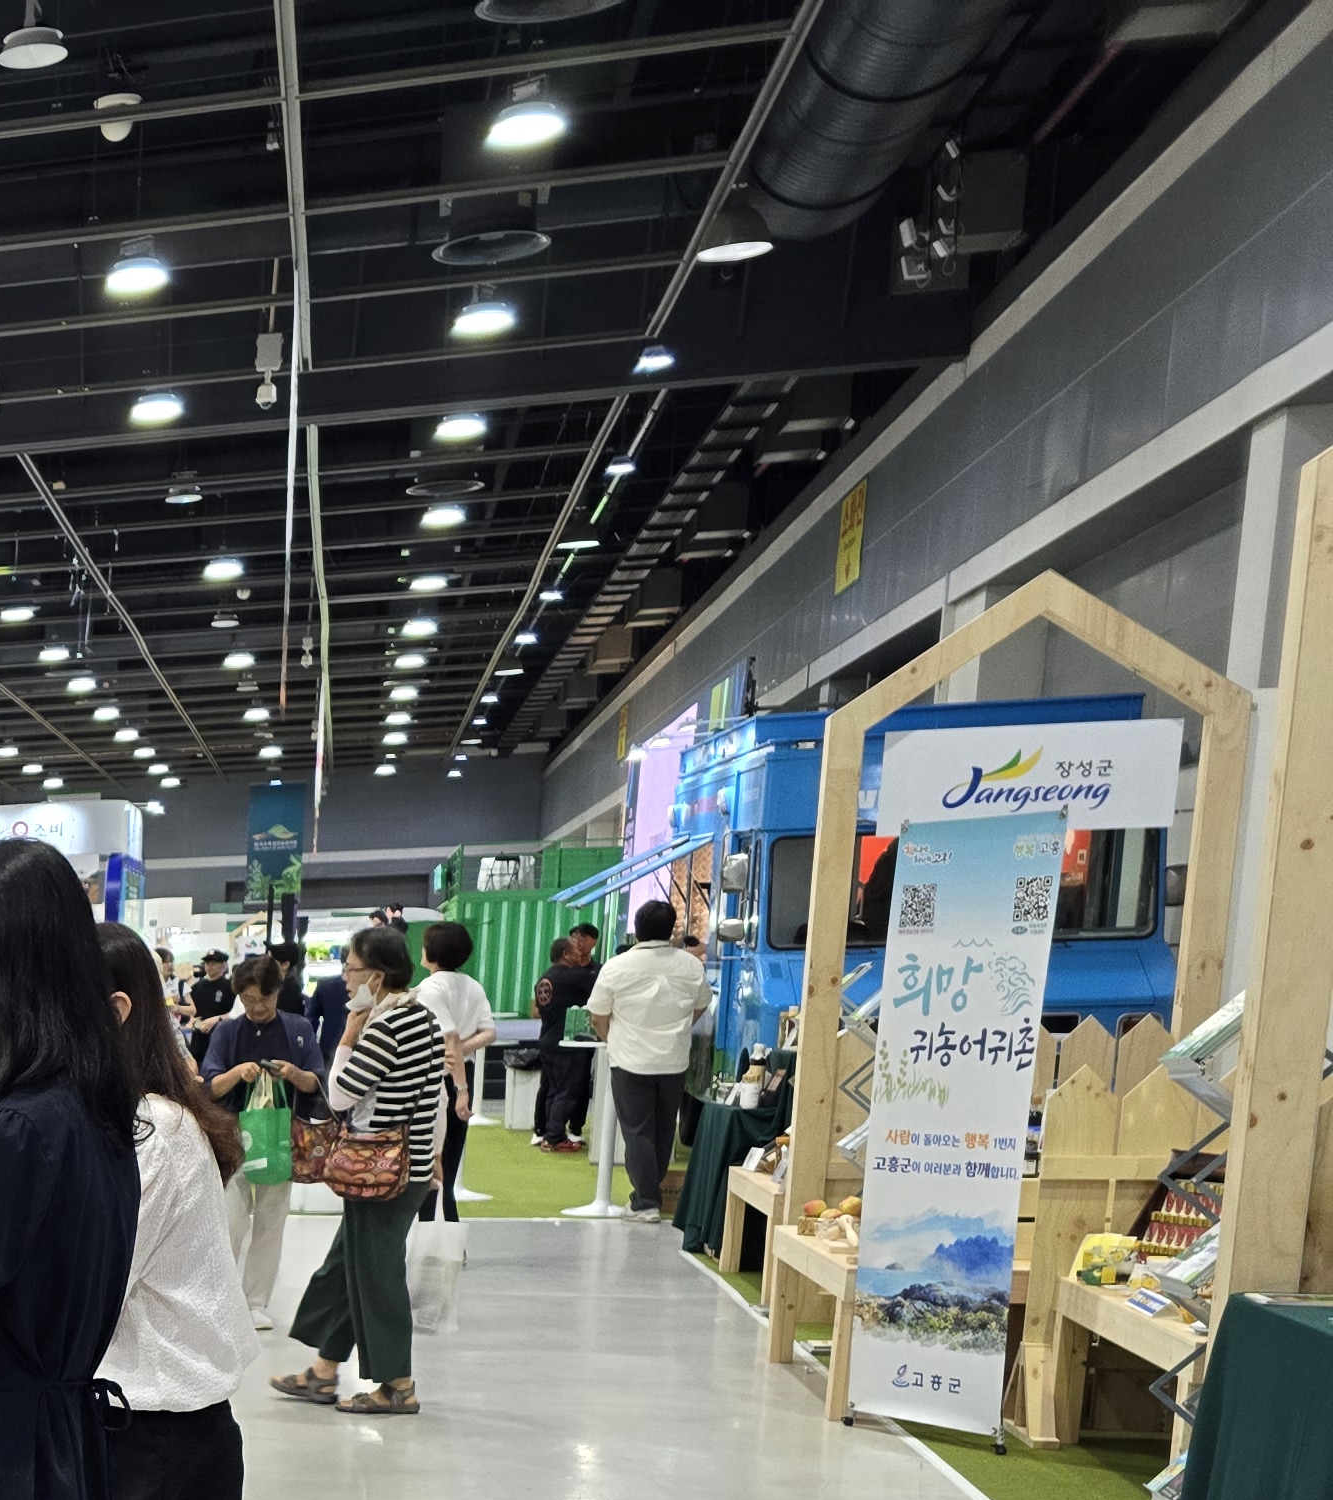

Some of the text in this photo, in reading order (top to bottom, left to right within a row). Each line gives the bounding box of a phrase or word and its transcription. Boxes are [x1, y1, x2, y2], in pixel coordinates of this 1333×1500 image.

[1055, 759, 1114, 779] 장성군
[942, 766, 1112, 812] Jangseong
[892, 953, 983, 1017] 희망
[910, 1017, 1035, 1071] 귀농어귀촌
[885, 1129, 1017, 1151] 사람이 돌아오는 행복 1번지
[873, 1156, 1020, 1181] 고흥군이 여러분과 함께합니다.
[912, 1371, 961, 1394] 고흥군
